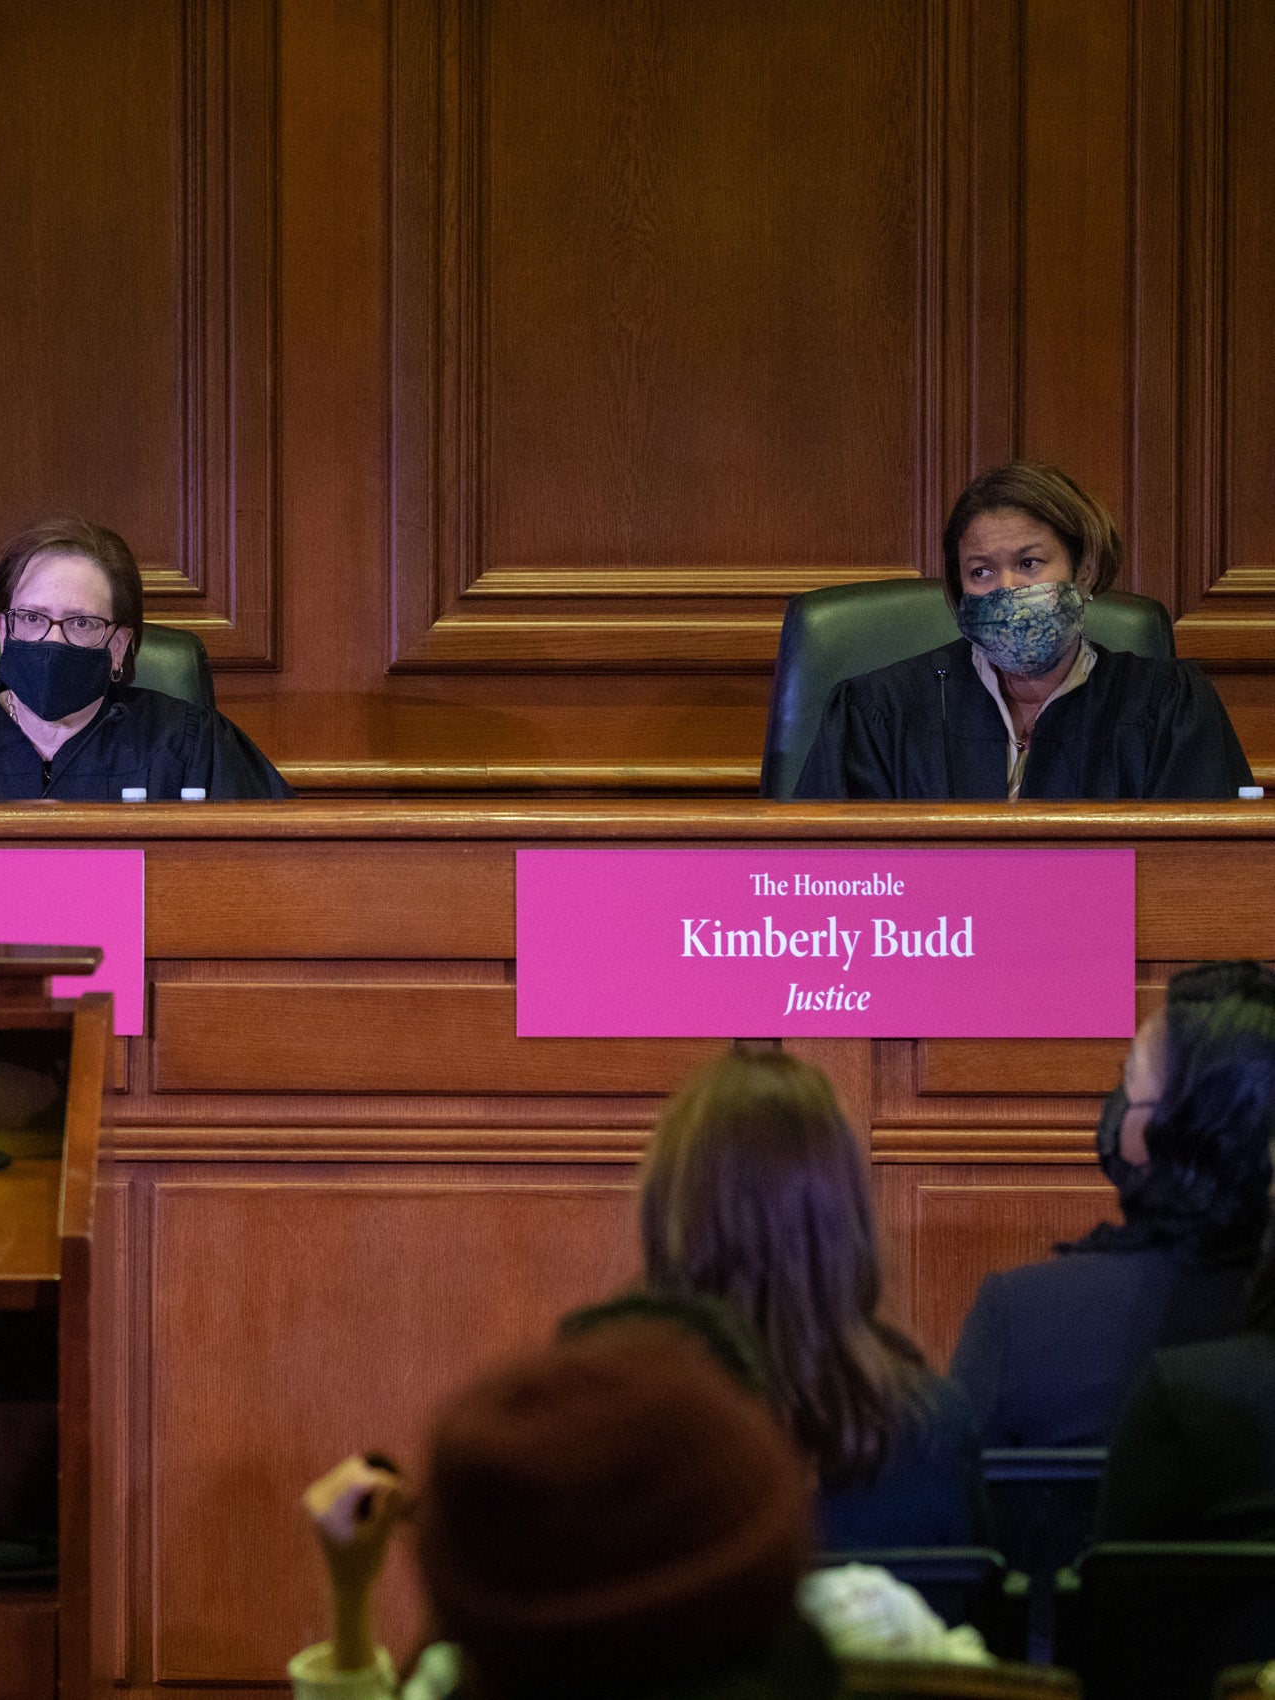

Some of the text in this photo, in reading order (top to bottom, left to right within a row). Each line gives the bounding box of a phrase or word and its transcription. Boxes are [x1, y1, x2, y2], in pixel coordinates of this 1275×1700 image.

[749, 872, 905, 896] The Honorable
[680, 915, 975, 972] Kimberly Budd
[783, 983, 871, 1016] Justice
